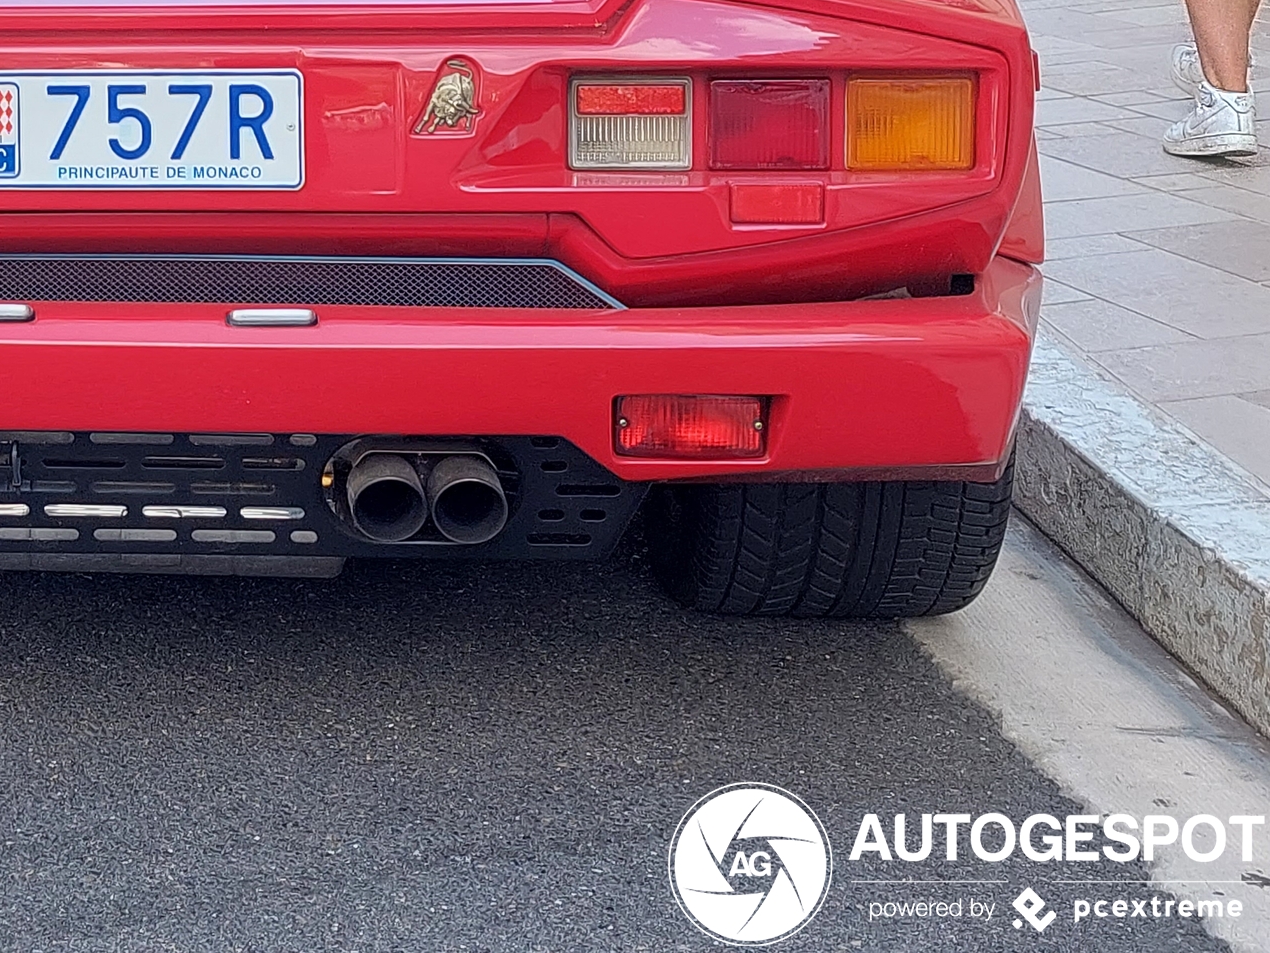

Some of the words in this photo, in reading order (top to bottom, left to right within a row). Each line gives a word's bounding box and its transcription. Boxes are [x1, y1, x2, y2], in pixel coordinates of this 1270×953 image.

[46, 84, 274, 161] 757R
[58, 166, 159, 179] PRINCIPAUTE
[166, 166, 186, 179] DE
[193, 166, 262, 179] MONACO
